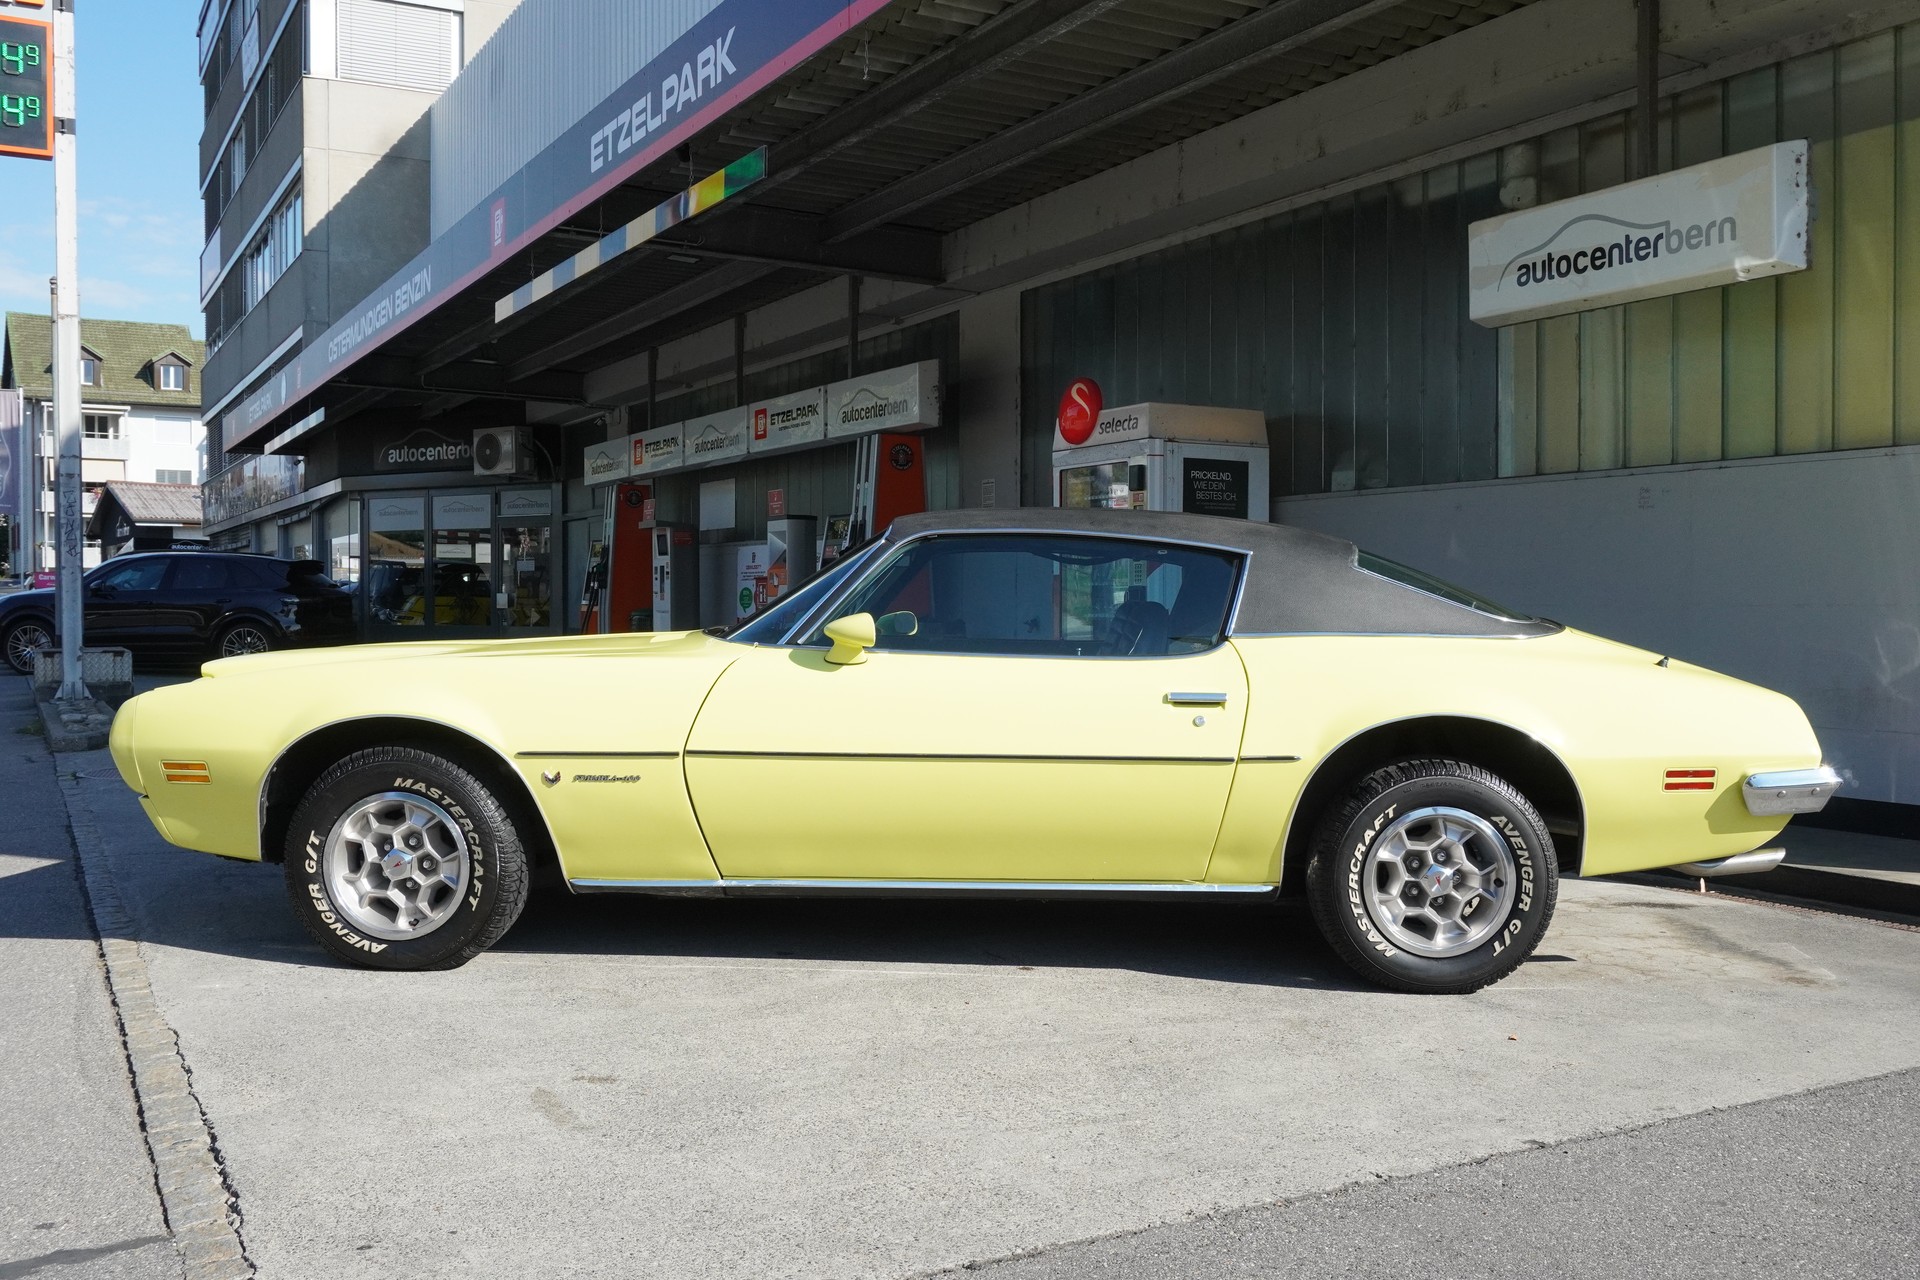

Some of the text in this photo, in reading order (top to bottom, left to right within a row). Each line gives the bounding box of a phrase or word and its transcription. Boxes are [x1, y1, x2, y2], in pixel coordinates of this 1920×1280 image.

[590, 26, 737, 173] ETZELPARK
[1516, 216, 1737, 287] autocenterbern
[328, 264, 432, 363] OSTERMUNDIGEN BENZIN
[770, 402, 819, 426] ETZELPARK
[841, 398, 908, 424] autocenterbern
[1098, 414, 1139, 435] selecta
[645, 436, 680, 454] ETZELPARK
[694, 433, 740, 454] autocenterbern
[591, 458, 624, 476] autocenterbern
[1190, 470, 1232, 482] PRICKELND,
[1193, 480, 1226, 491] WIE DEIN
[1196, 490, 1222, 500] BESTES
[393, 777, 484, 912] MASTERCRAFT
[1490, 815, 1535, 912] AVENGER
[1348, 803, 1398, 958] MASTERCRAFT
[307, 883, 388, 954] AVENGER
